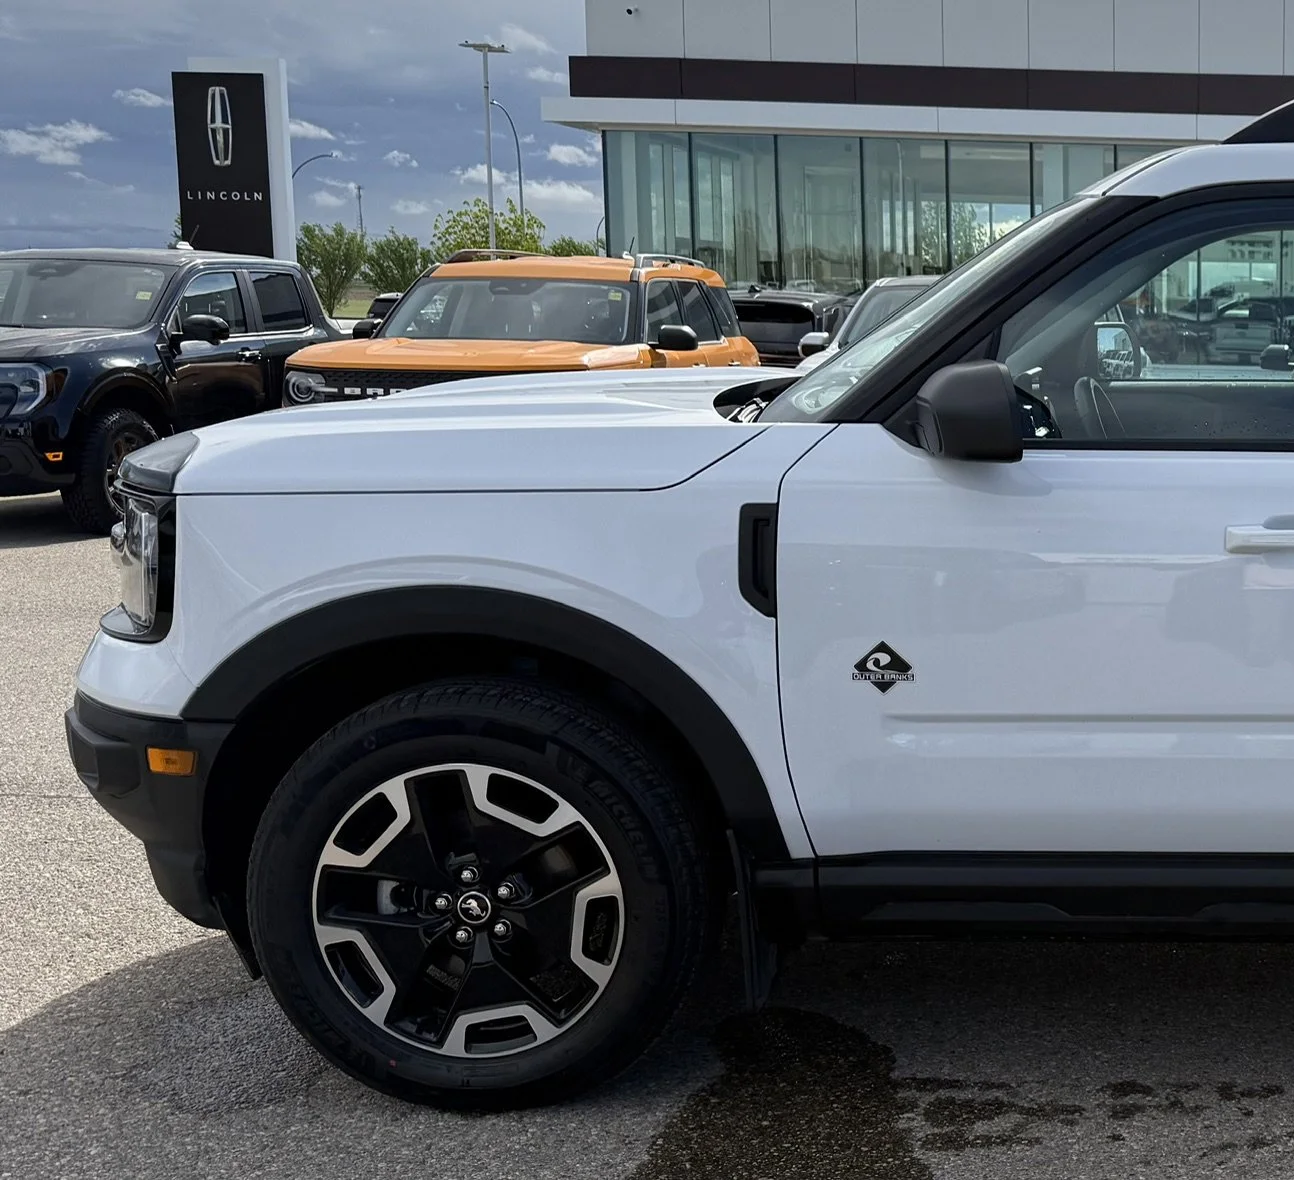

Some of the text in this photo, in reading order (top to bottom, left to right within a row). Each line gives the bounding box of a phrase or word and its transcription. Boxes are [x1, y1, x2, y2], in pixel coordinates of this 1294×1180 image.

[187, 190, 263, 201] LINCOLN
[853, 673, 914, 681] OUTER BANKS
[588, 780, 660, 881] MICHELIN
